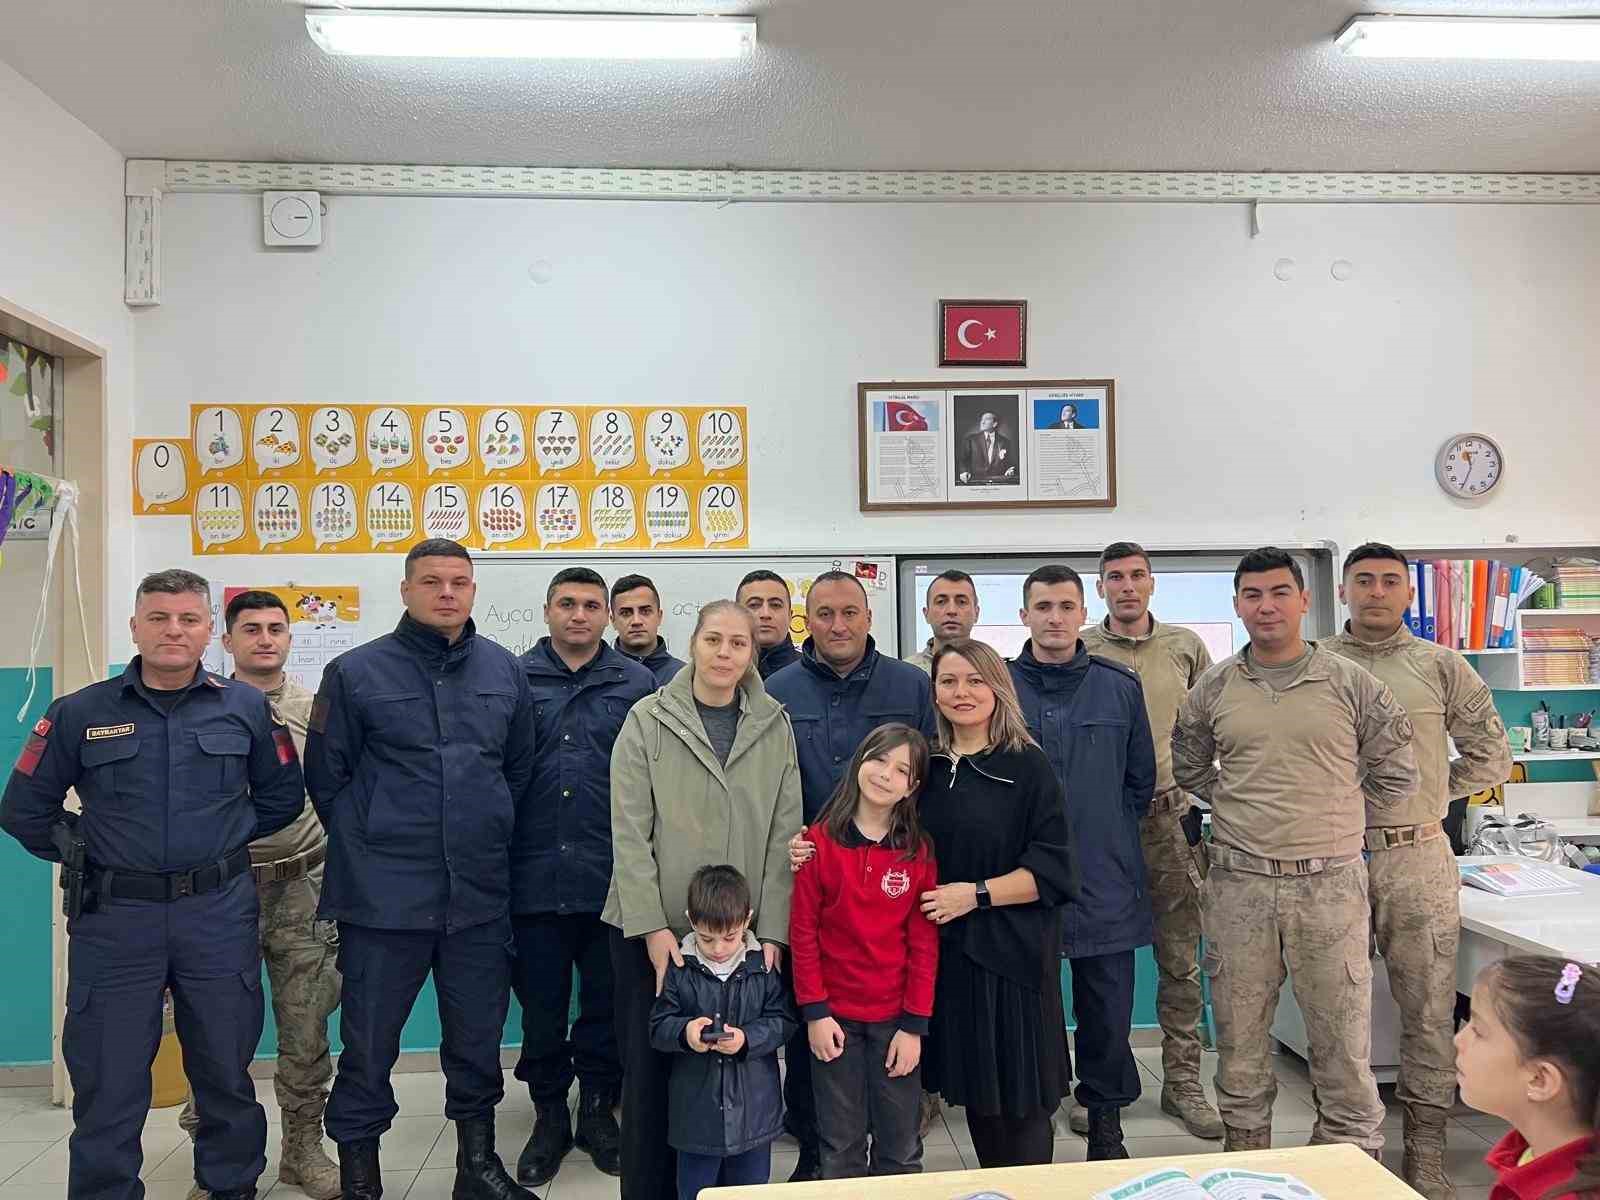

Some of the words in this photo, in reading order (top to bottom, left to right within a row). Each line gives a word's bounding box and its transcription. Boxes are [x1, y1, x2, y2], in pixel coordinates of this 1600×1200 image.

[214, 410, 223, 433] 1
[270, 410, 283, 432] 2
[326, 410, 340, 432] 3
[380, 410, 398, 432] 4
[439, 410, 452, 433] 5
[495, 411, 509, 433] 6
[550, 411, 563, 434] 7
[606, 412, 619, 434] 8
[661, 412, 673, 434] 9
[708, 412, 733, 434] 10
[154, 445, 170, 468] 0
[210, 485, 229, 508] 11
[265, 485, 289, 508] 12
[321, 484, 346, 507] 13
[376, 484, 404, 507] 14
[434, 485, 458, 508] 15
[489, 486, 515, 508] 16
[546, 486, 569, 508] 17
[600, 486, 625, 508] 18
[655, 486, 679, 508] 19
[707, 486, 736, 508] 20
